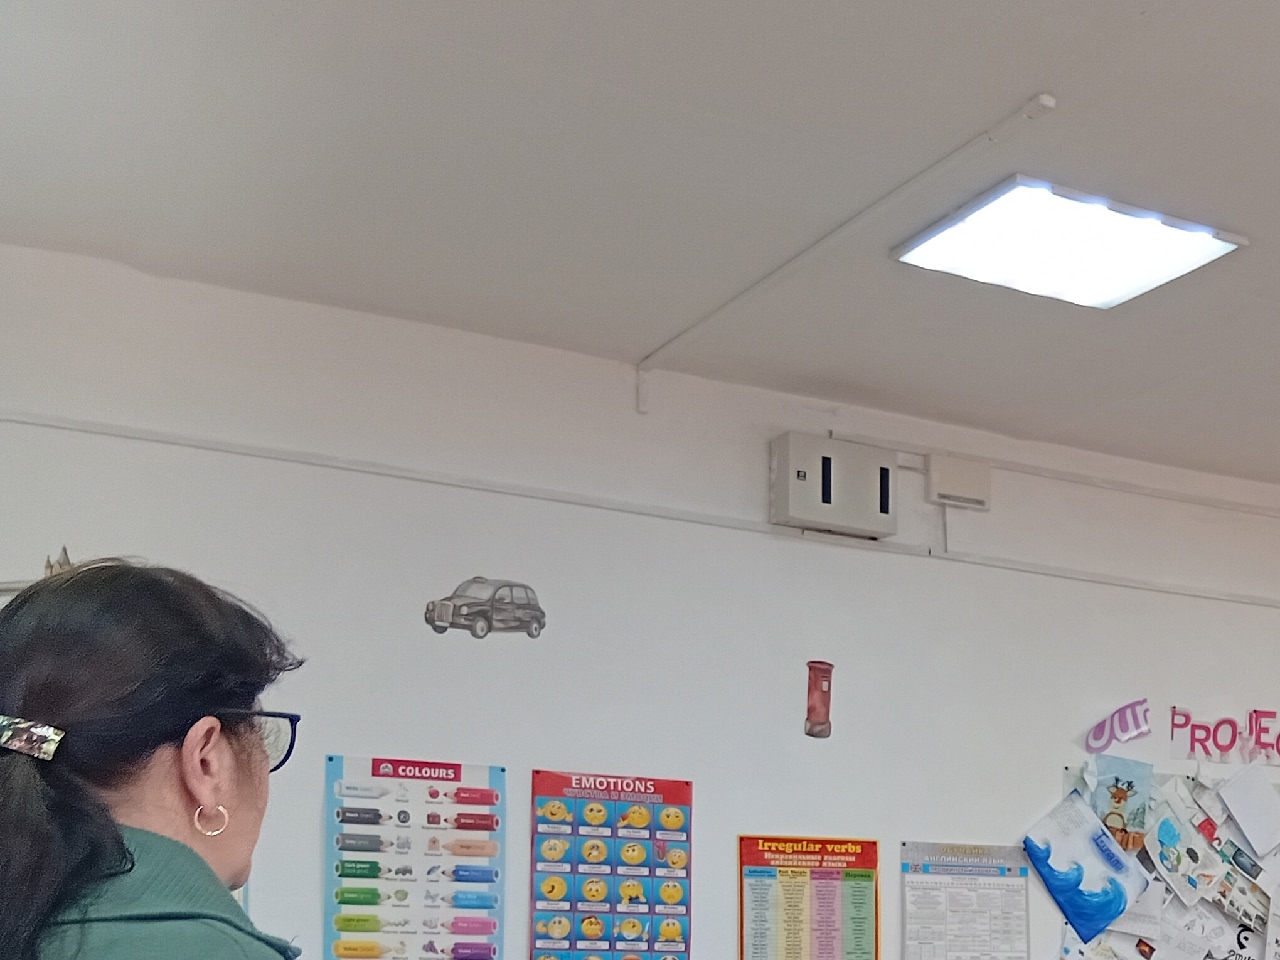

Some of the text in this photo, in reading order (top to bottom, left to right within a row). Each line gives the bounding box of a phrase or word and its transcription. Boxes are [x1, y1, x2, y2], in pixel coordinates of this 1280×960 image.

[397, 765, 456, 780] COLOURS
[571, 775, 655, 793] EMOTIONS
[757, 839, 862, 854] Irregular verbs
